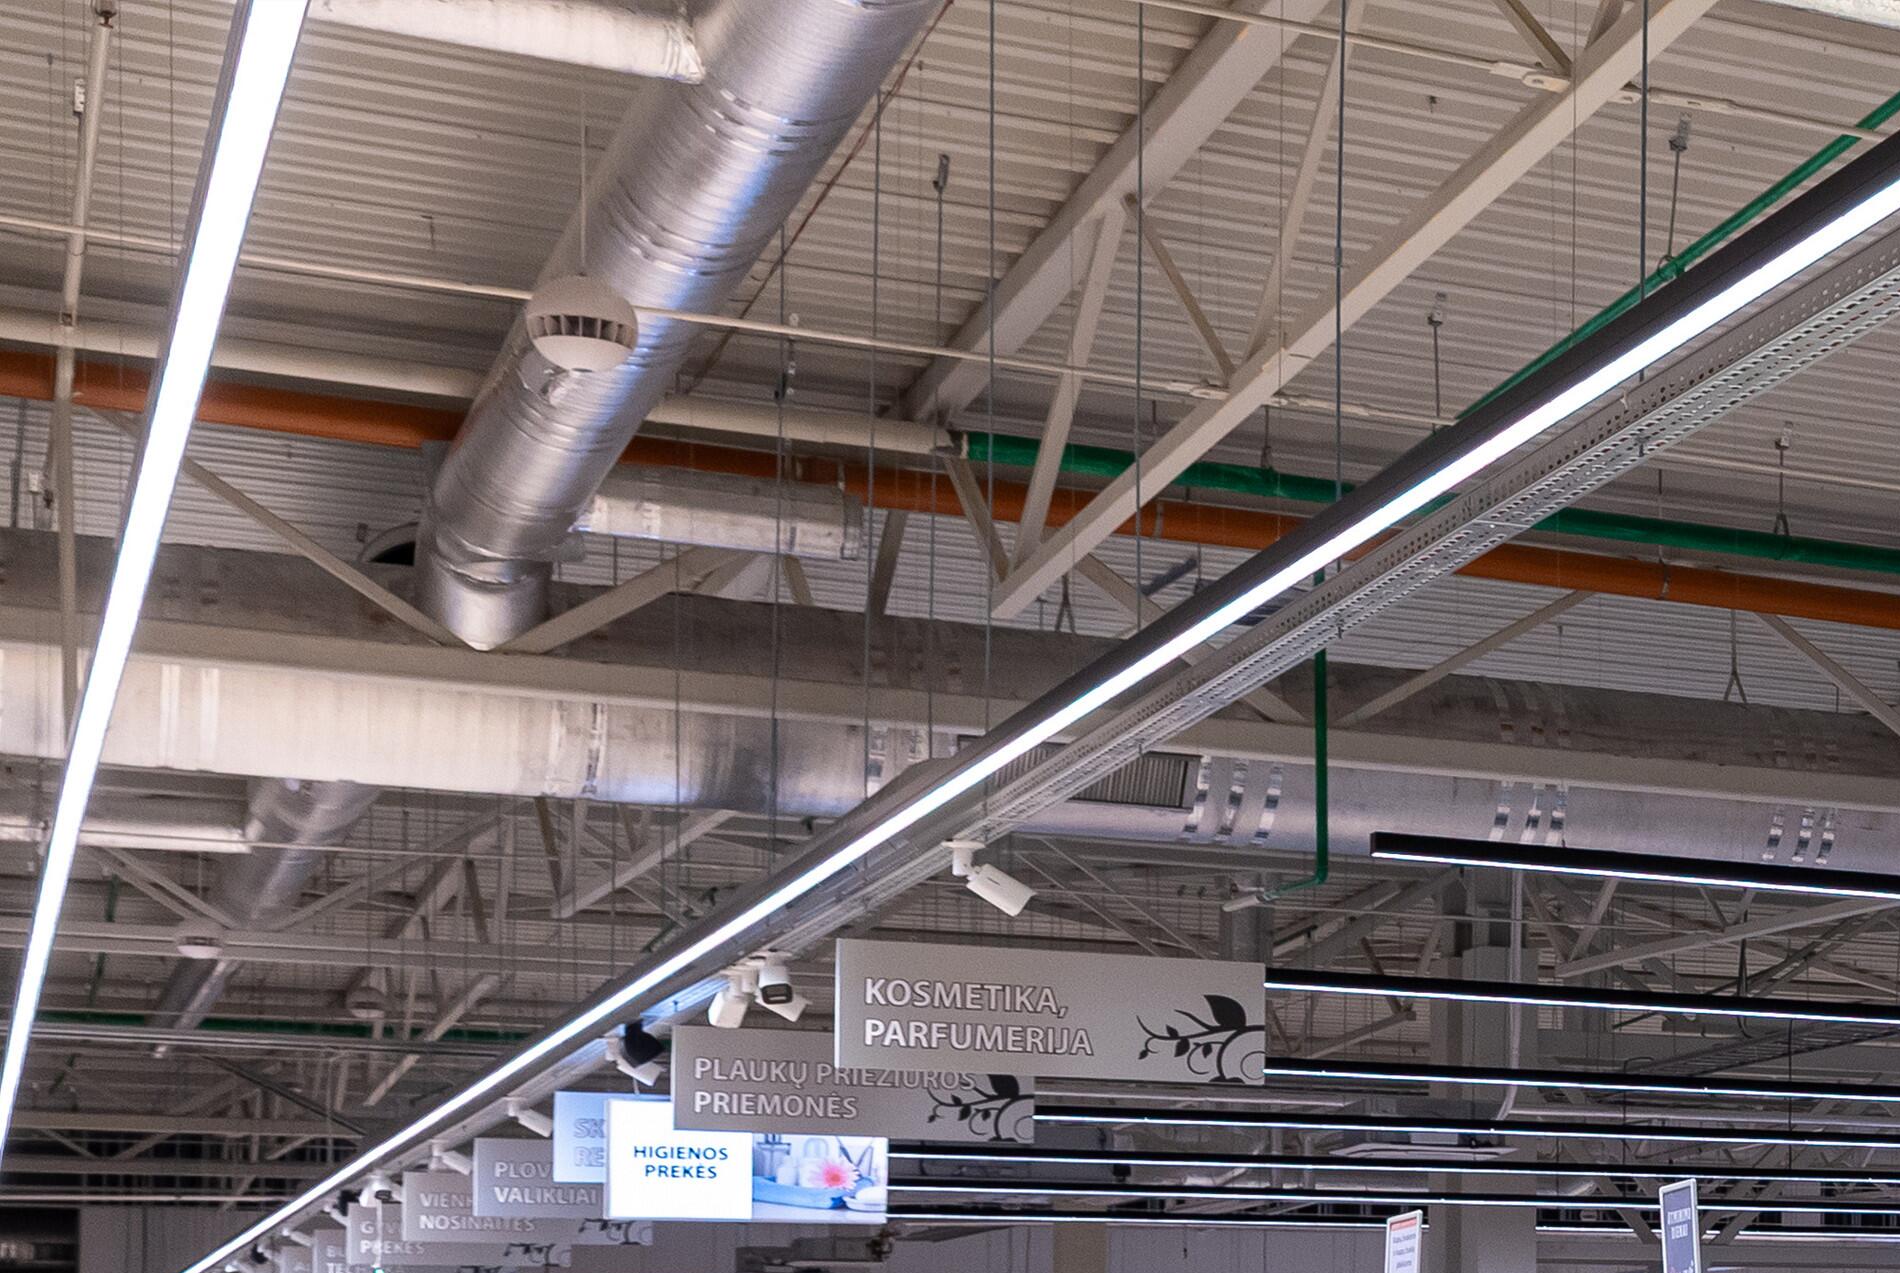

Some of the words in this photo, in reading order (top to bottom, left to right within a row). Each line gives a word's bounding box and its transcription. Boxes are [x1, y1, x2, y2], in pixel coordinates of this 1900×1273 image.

[864, 976, 1067, 1017] KOSMETIKA,
[864, 1018, 1094, 1056] PARFUMERIJA
[694, 1057, 806, 1088] PLAUKŲ
[694, 1091, 858, 1118] PRIEMONĖS
[633, 1145, 729, 1161] HIGIENOS
[494, 1161, 552, 1178] PLOV
[644, 1163, 718, 1179] PREKĖS
[419, 1192, 474, 1209] VIEN
[494, 1186, 597, 1205] VALIKLIAI
